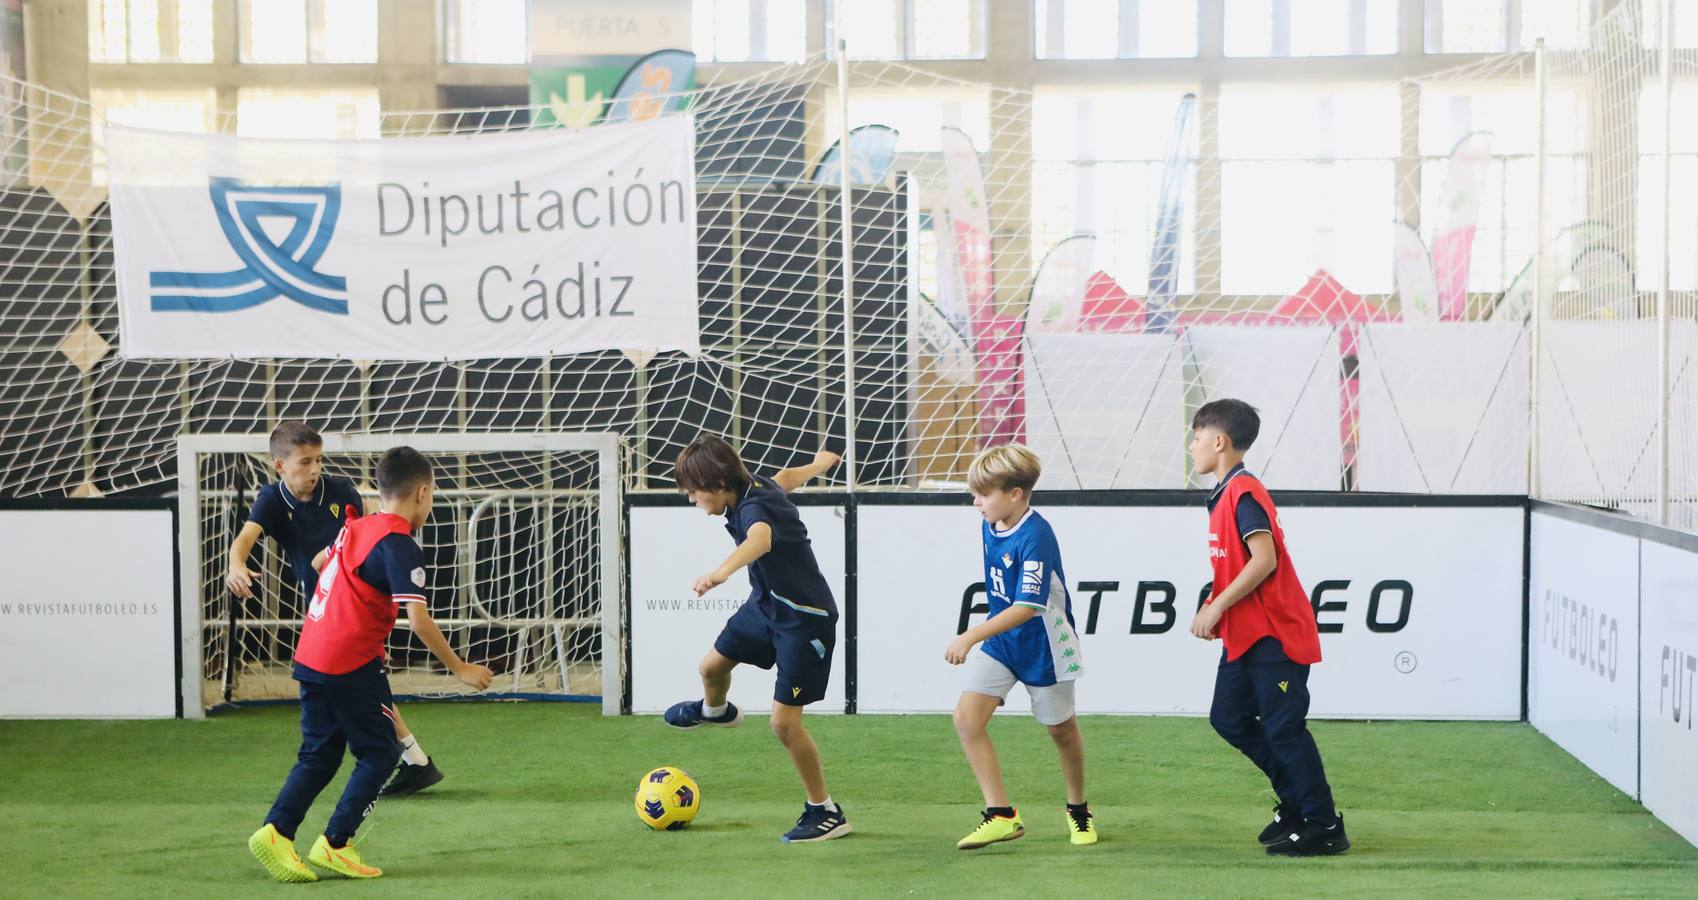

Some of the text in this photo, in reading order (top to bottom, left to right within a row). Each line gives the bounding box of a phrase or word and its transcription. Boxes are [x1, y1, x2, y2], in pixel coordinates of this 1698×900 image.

[555, 15, 639, 39] PUERTA
[377, 168, 685, 247] Diputación
[381, 261, 635, 325] de Cádiz
[957, 580, 1414, 635] FTBEO
[1544, 589, 1618, 682] FUTBOLEO
